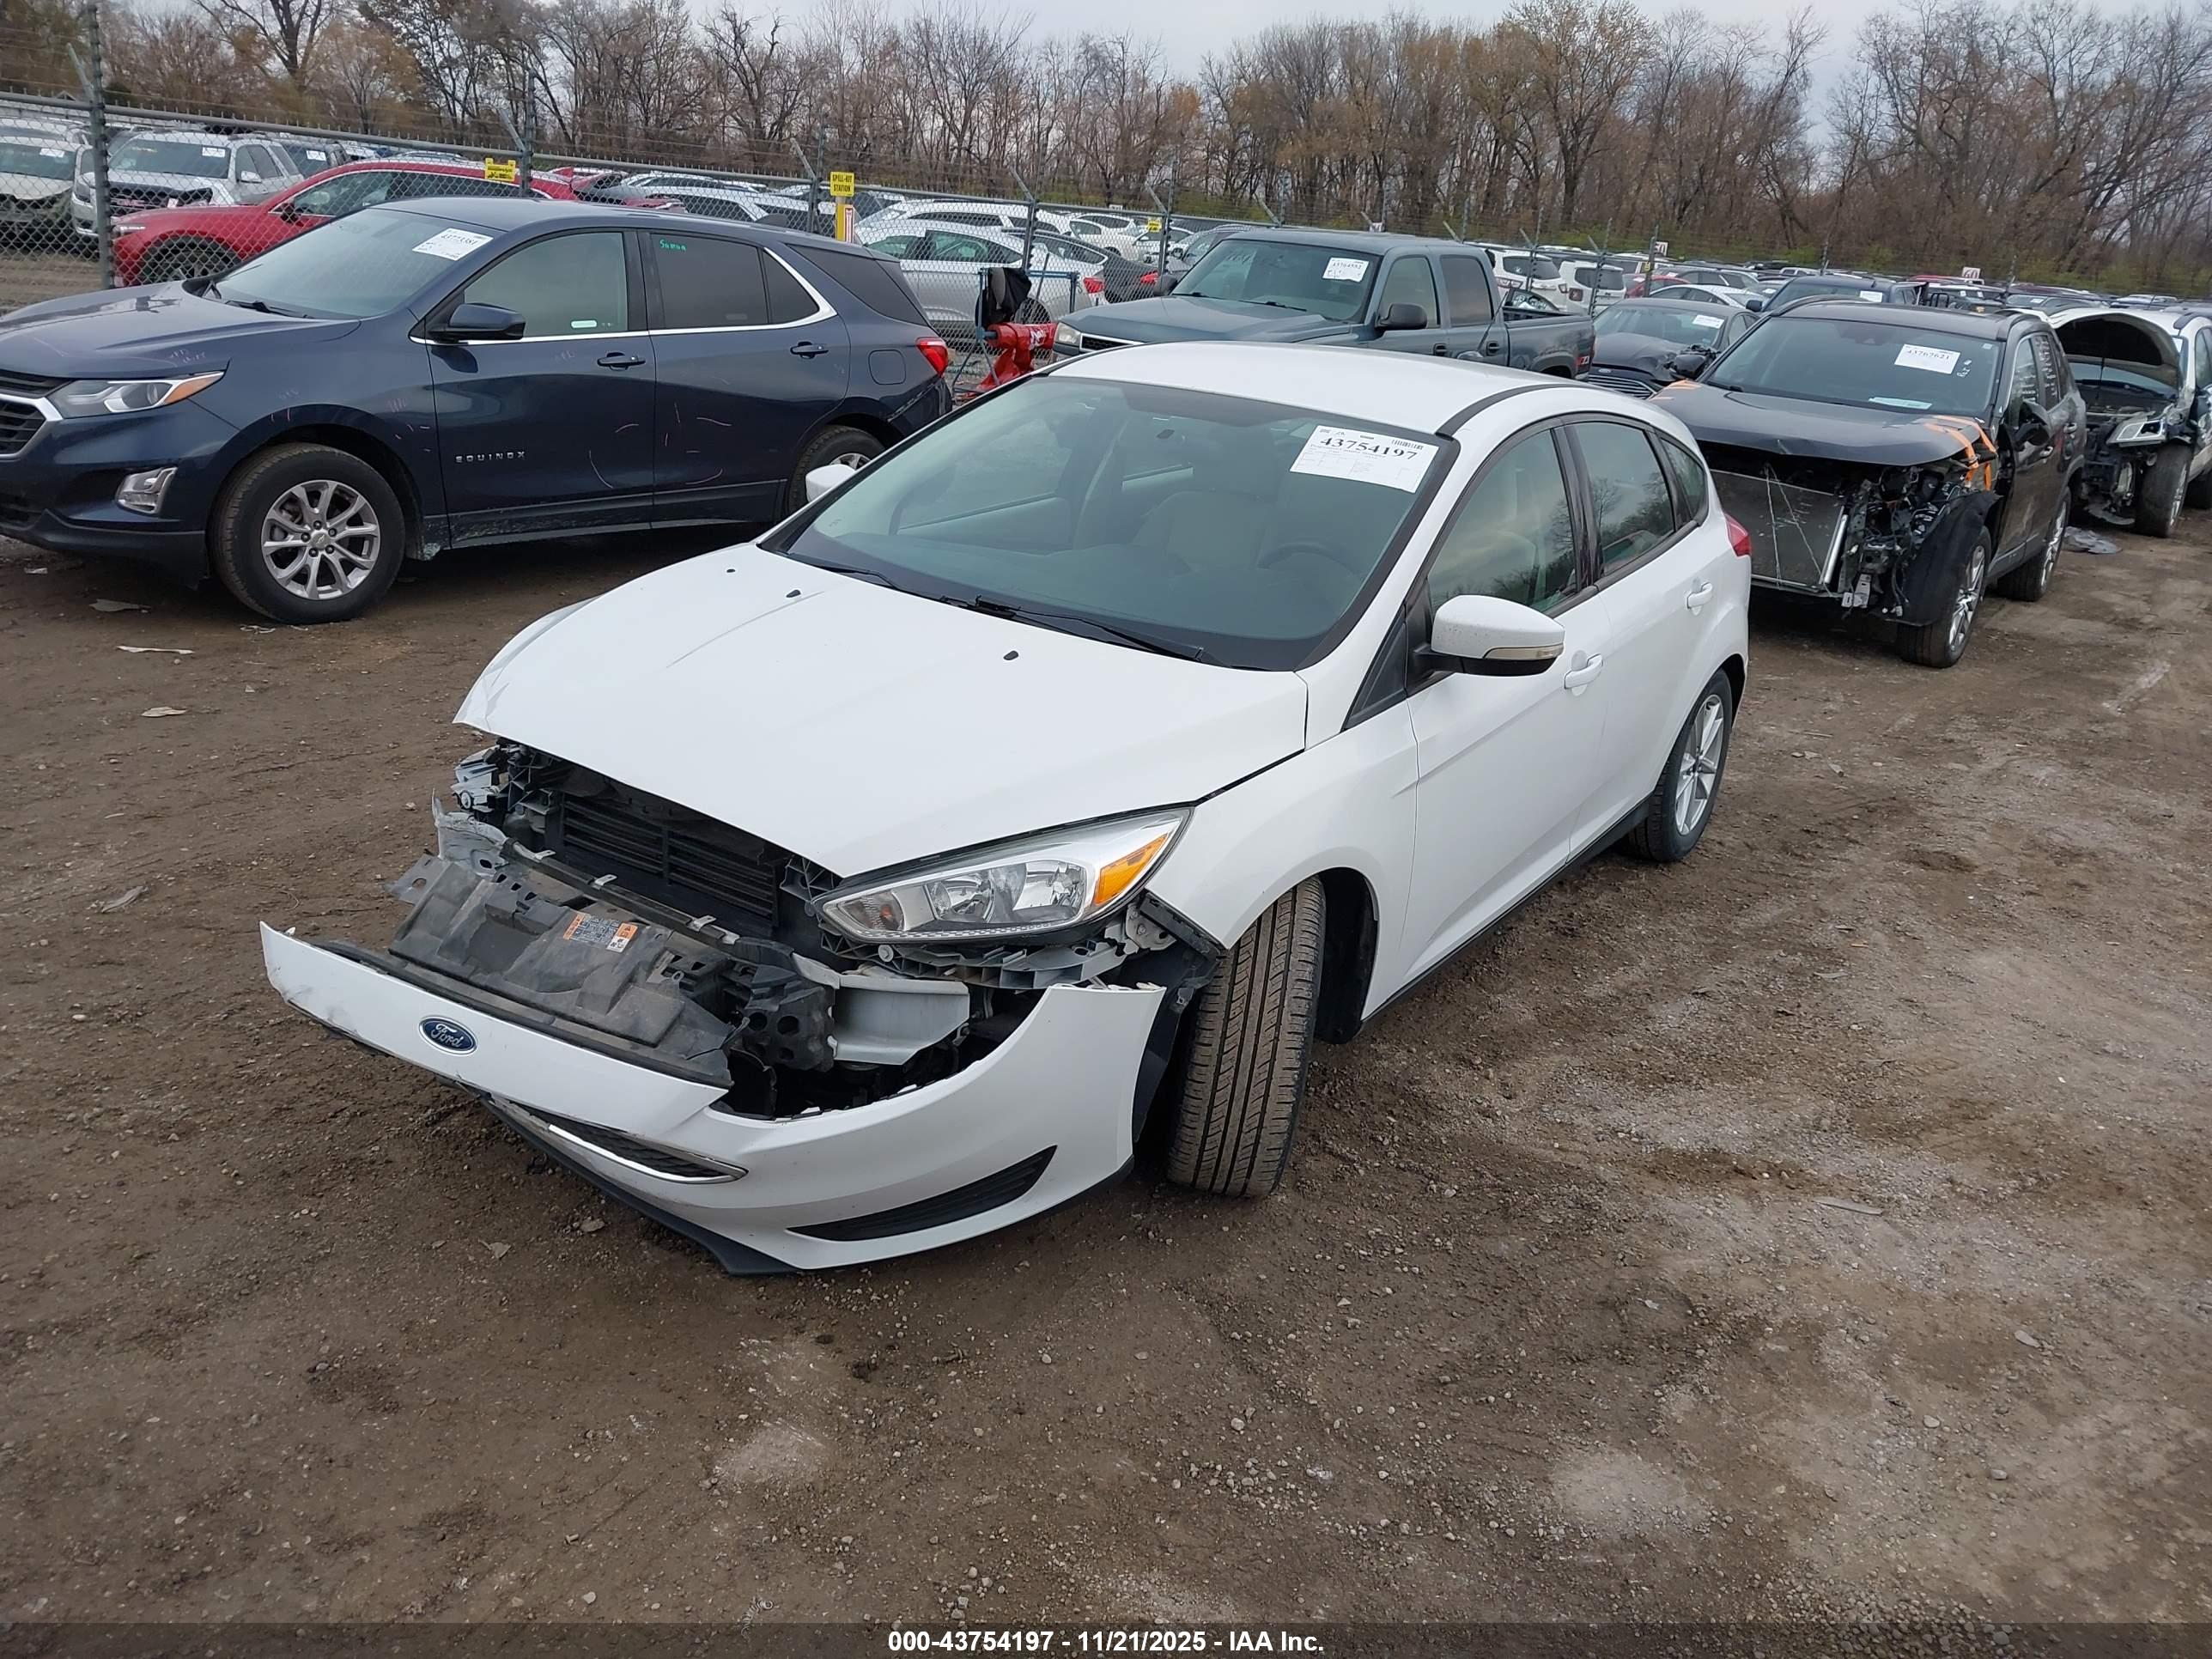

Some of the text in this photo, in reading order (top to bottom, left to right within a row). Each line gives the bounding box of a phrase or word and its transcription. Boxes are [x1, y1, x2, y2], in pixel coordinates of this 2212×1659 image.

[832, 173, 853, 183] SPILL-KIT
[833, 184, 851, 192] STATION
[1320, 437, 1418, 460] 43754197
[455, 451, 525, 463] EQUINOX
[430, 1023, 465, 1048] Ford
